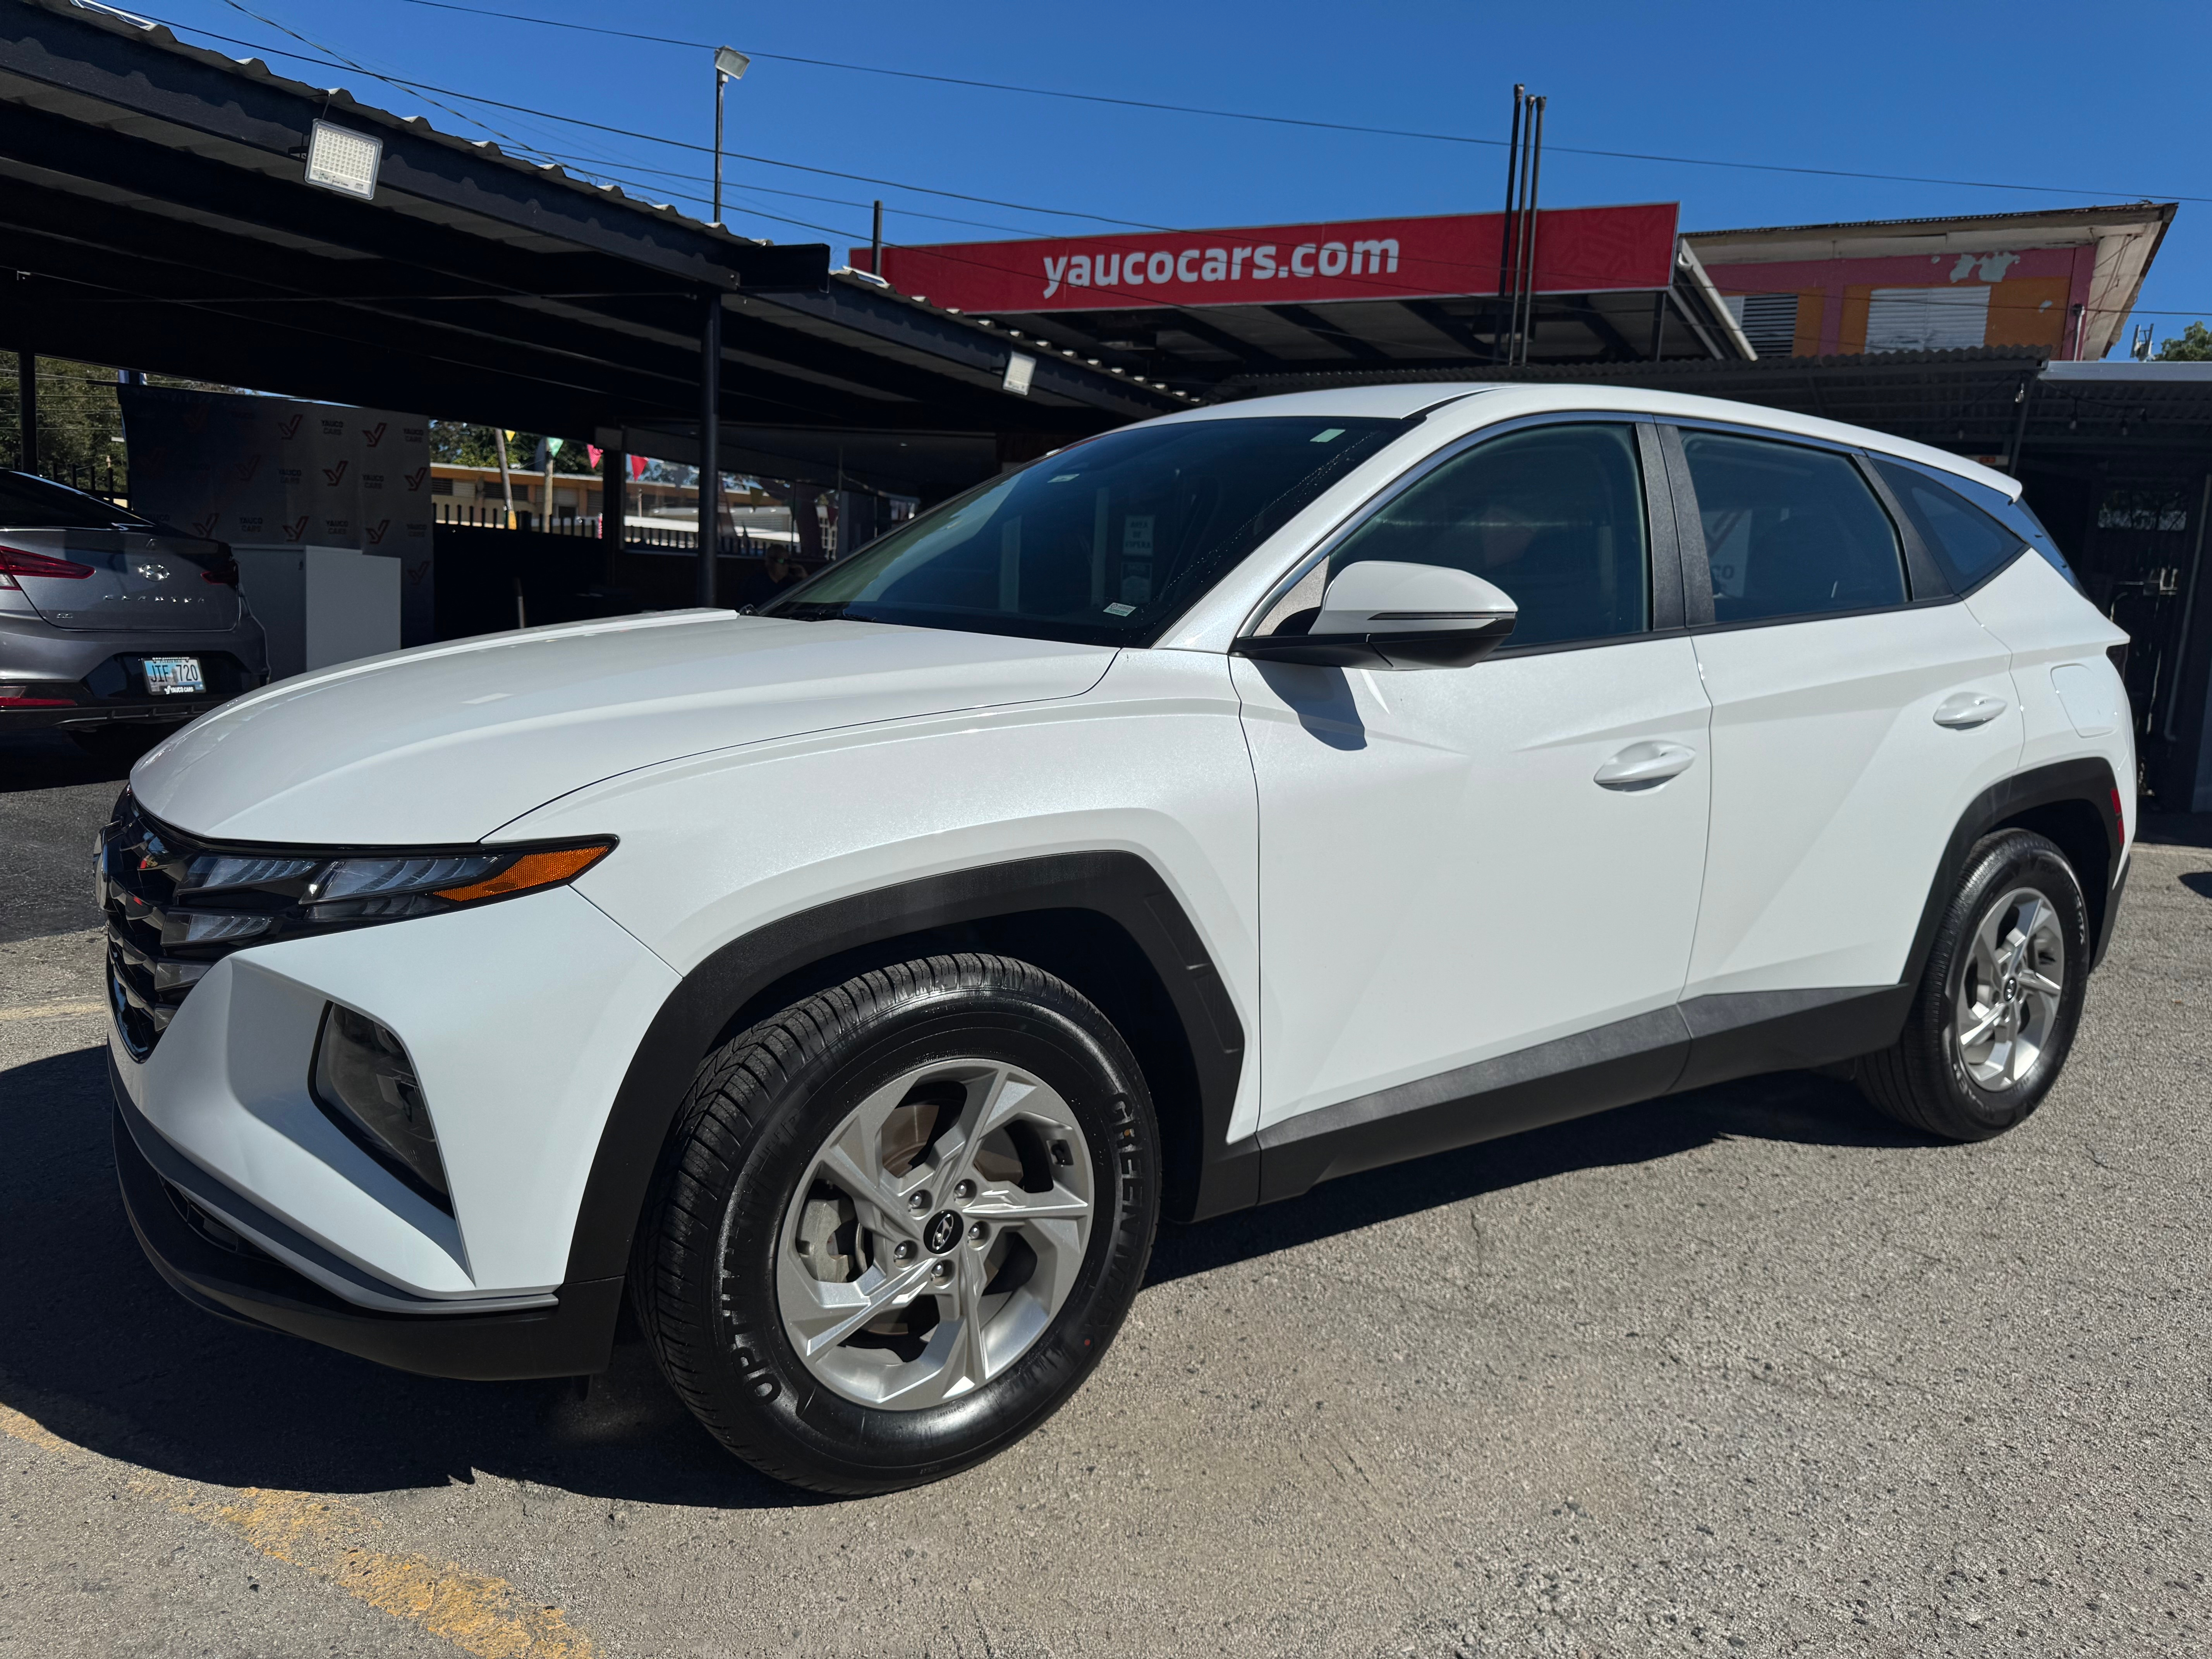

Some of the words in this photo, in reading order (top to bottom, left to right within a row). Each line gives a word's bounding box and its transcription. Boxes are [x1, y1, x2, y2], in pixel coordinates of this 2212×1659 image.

[1043, 238, 1399, 299] yaucocars.com
[322, 419, 343, 428] YAUCO
[323, 428, 342, 436] CARS
[404, 428, 424, 436] YAUCO
[278, 469, 301, 477] YAUCO
[363, 474, 384, 482] YAUCO
[241, 524, 261, 532] CARS
[103, 594, 204, 603] ELANTRA
[151, 665, 168, 682] JIF
[176, 665, 198, 681] 720
[722, 1165, 781, 1407] OPTIMUM
